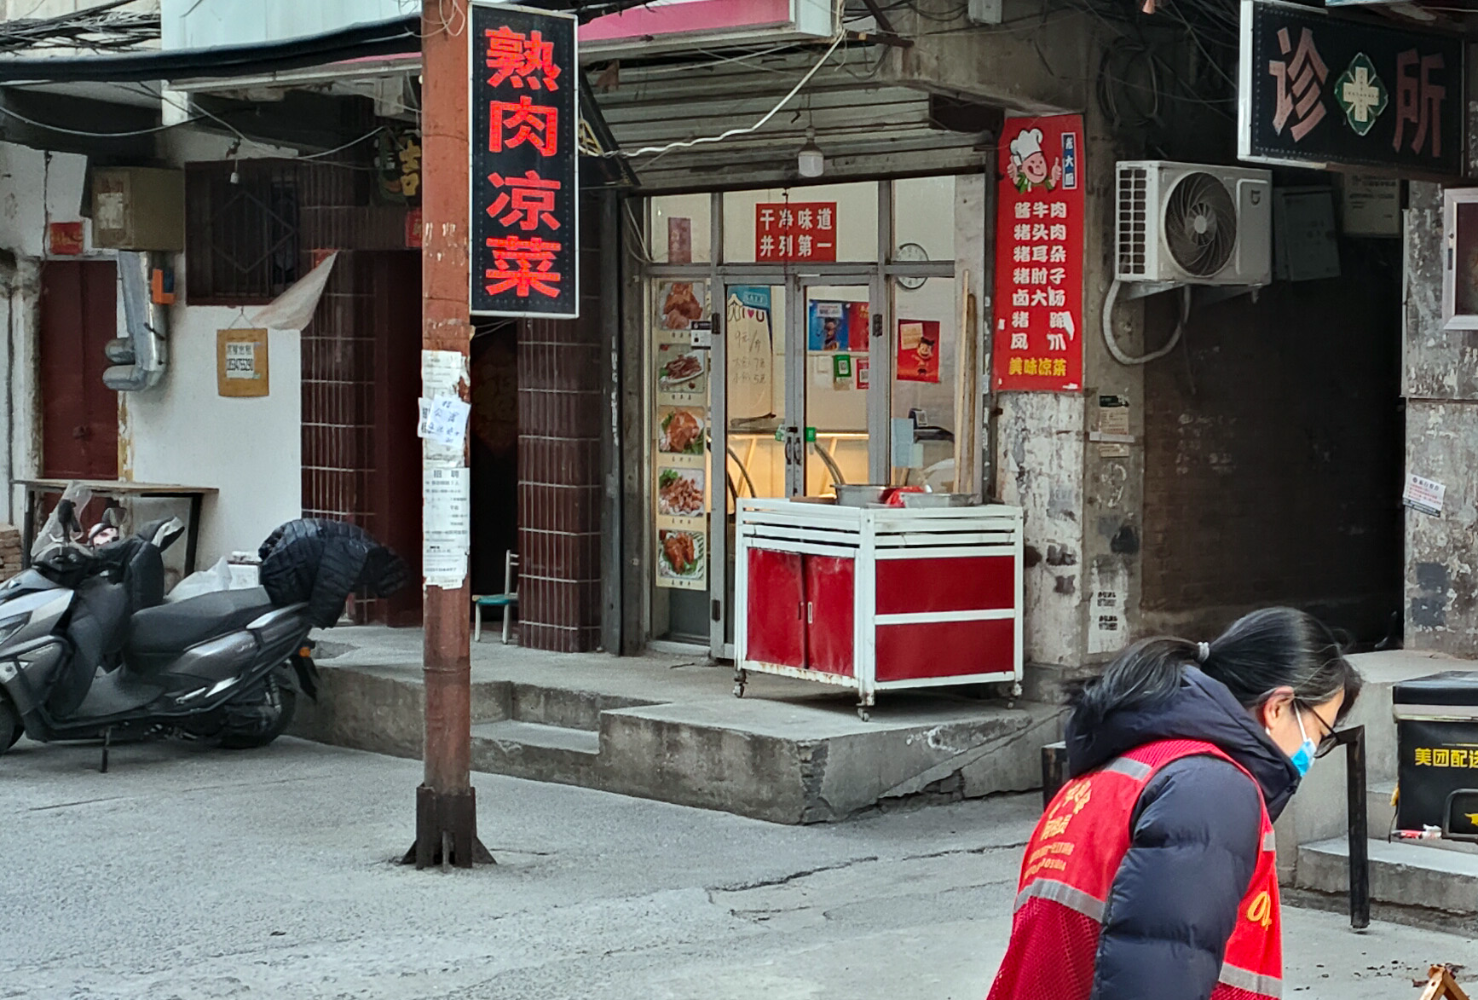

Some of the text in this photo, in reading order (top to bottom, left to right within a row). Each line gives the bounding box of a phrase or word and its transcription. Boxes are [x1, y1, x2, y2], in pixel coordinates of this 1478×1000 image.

[1269, 26, 1447, 158] 诊所
[485, 25, 562, 298] 熟肉凉菜
[760, 208, 832, 231] 干净味道
[1014, 202, 1067, 218] 酱牛肉
[1013, 223, 1067, 240] 猪头肉
[760, 235, 832, 257] 并列第一
[1013, 245, 1067, 262] 猪耳朵
[1012, 267, 1067, 285] 猪肘子
[1011, 286, 1066, 307] 卤大肠
[1008, 357, 1067, 376] 美味凉菜
